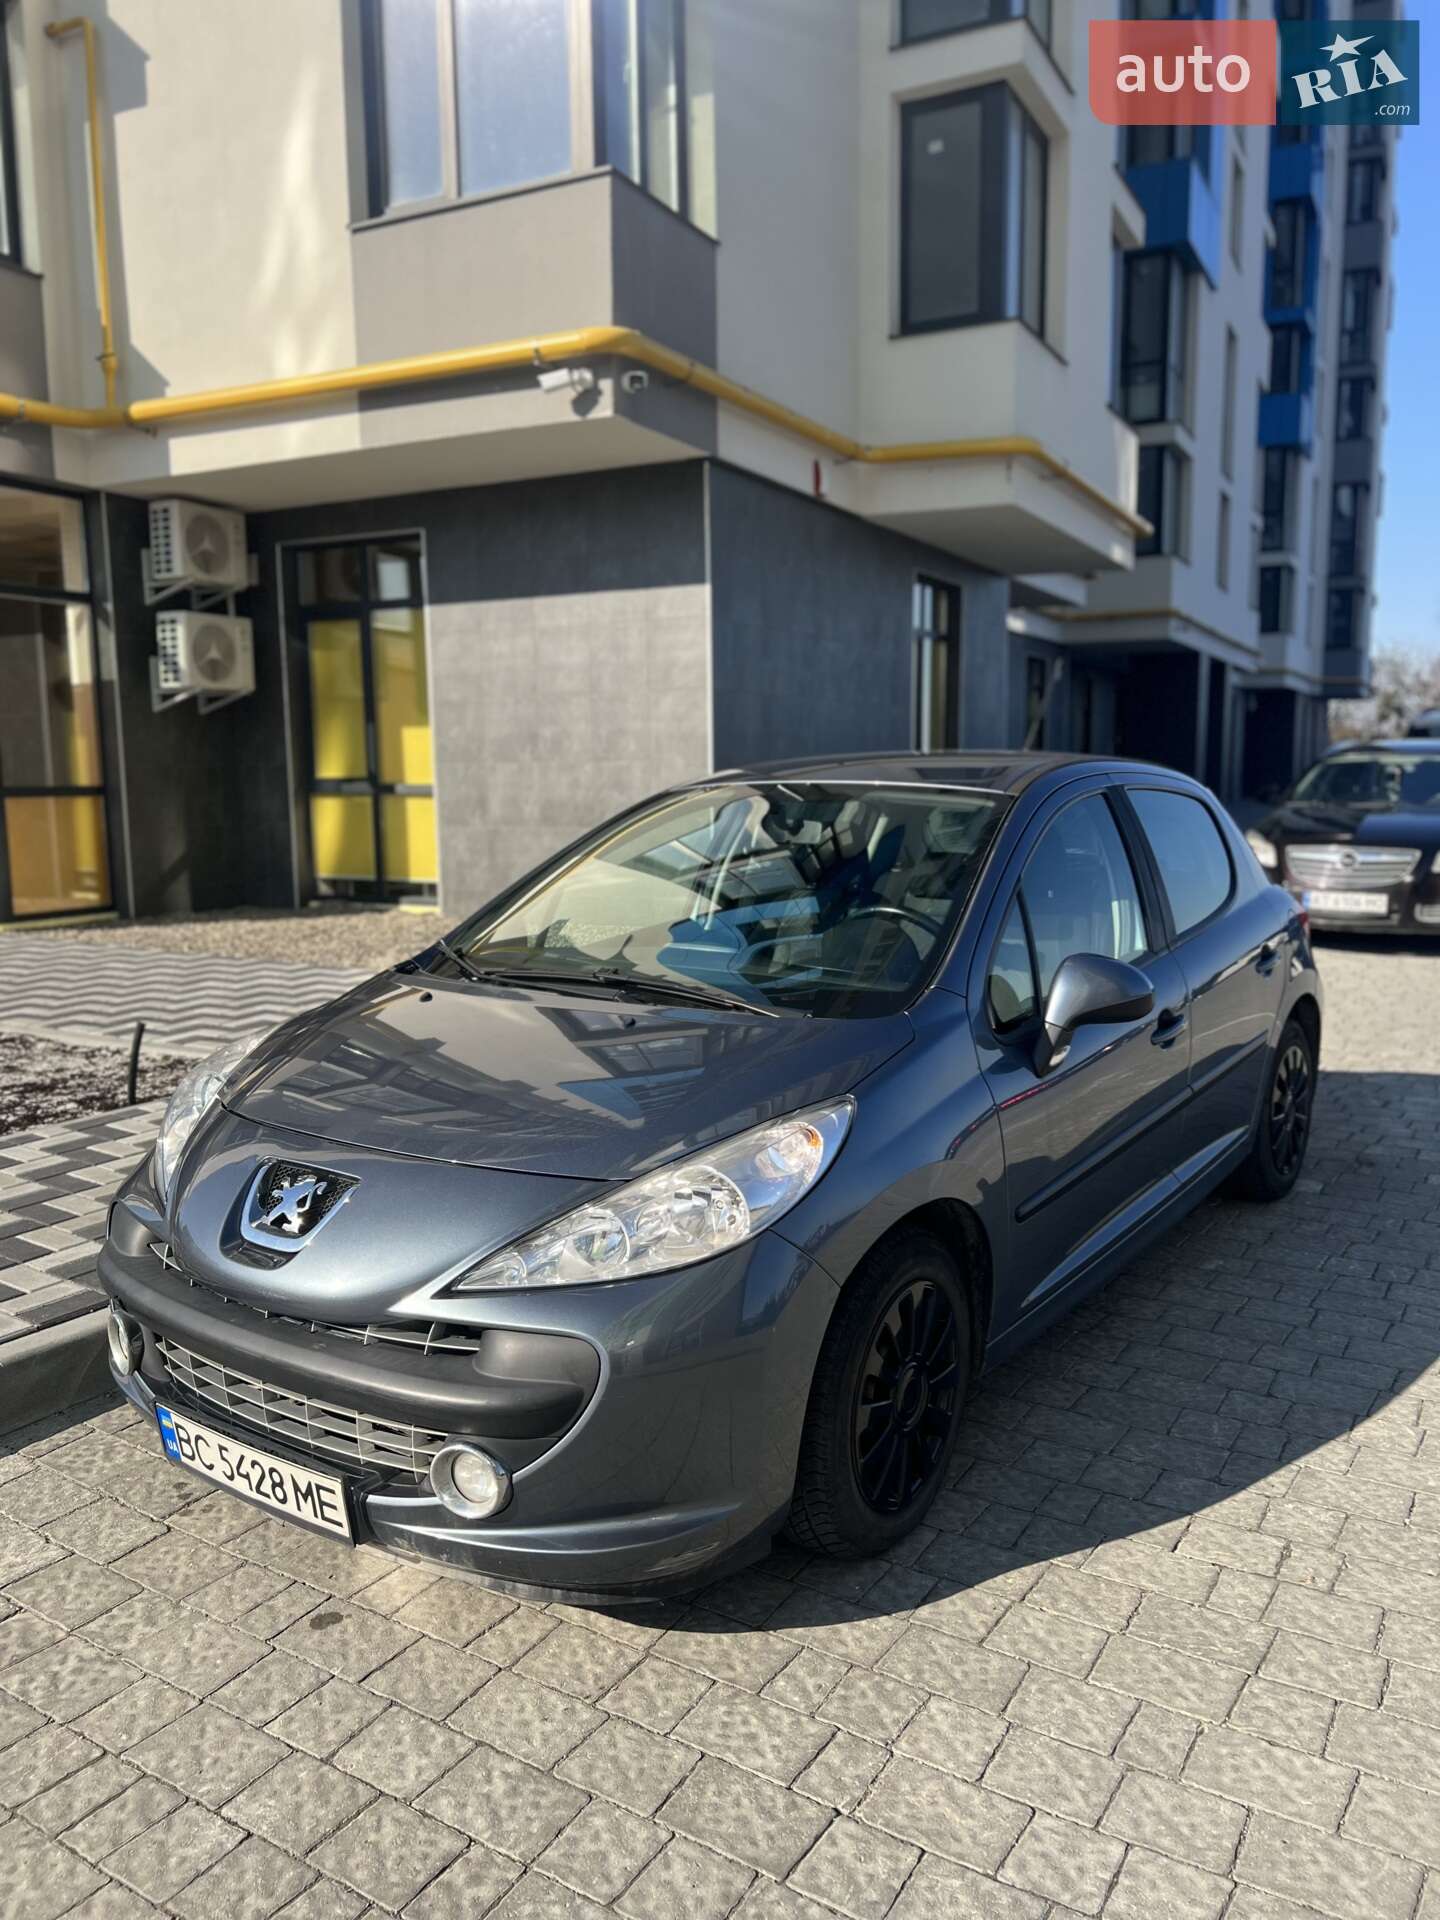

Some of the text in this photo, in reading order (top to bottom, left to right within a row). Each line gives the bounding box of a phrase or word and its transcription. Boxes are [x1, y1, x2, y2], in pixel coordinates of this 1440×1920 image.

[166, 1438, 179, 1453] UA
[175, 1422, 344, 1529] BC 5428 ME
